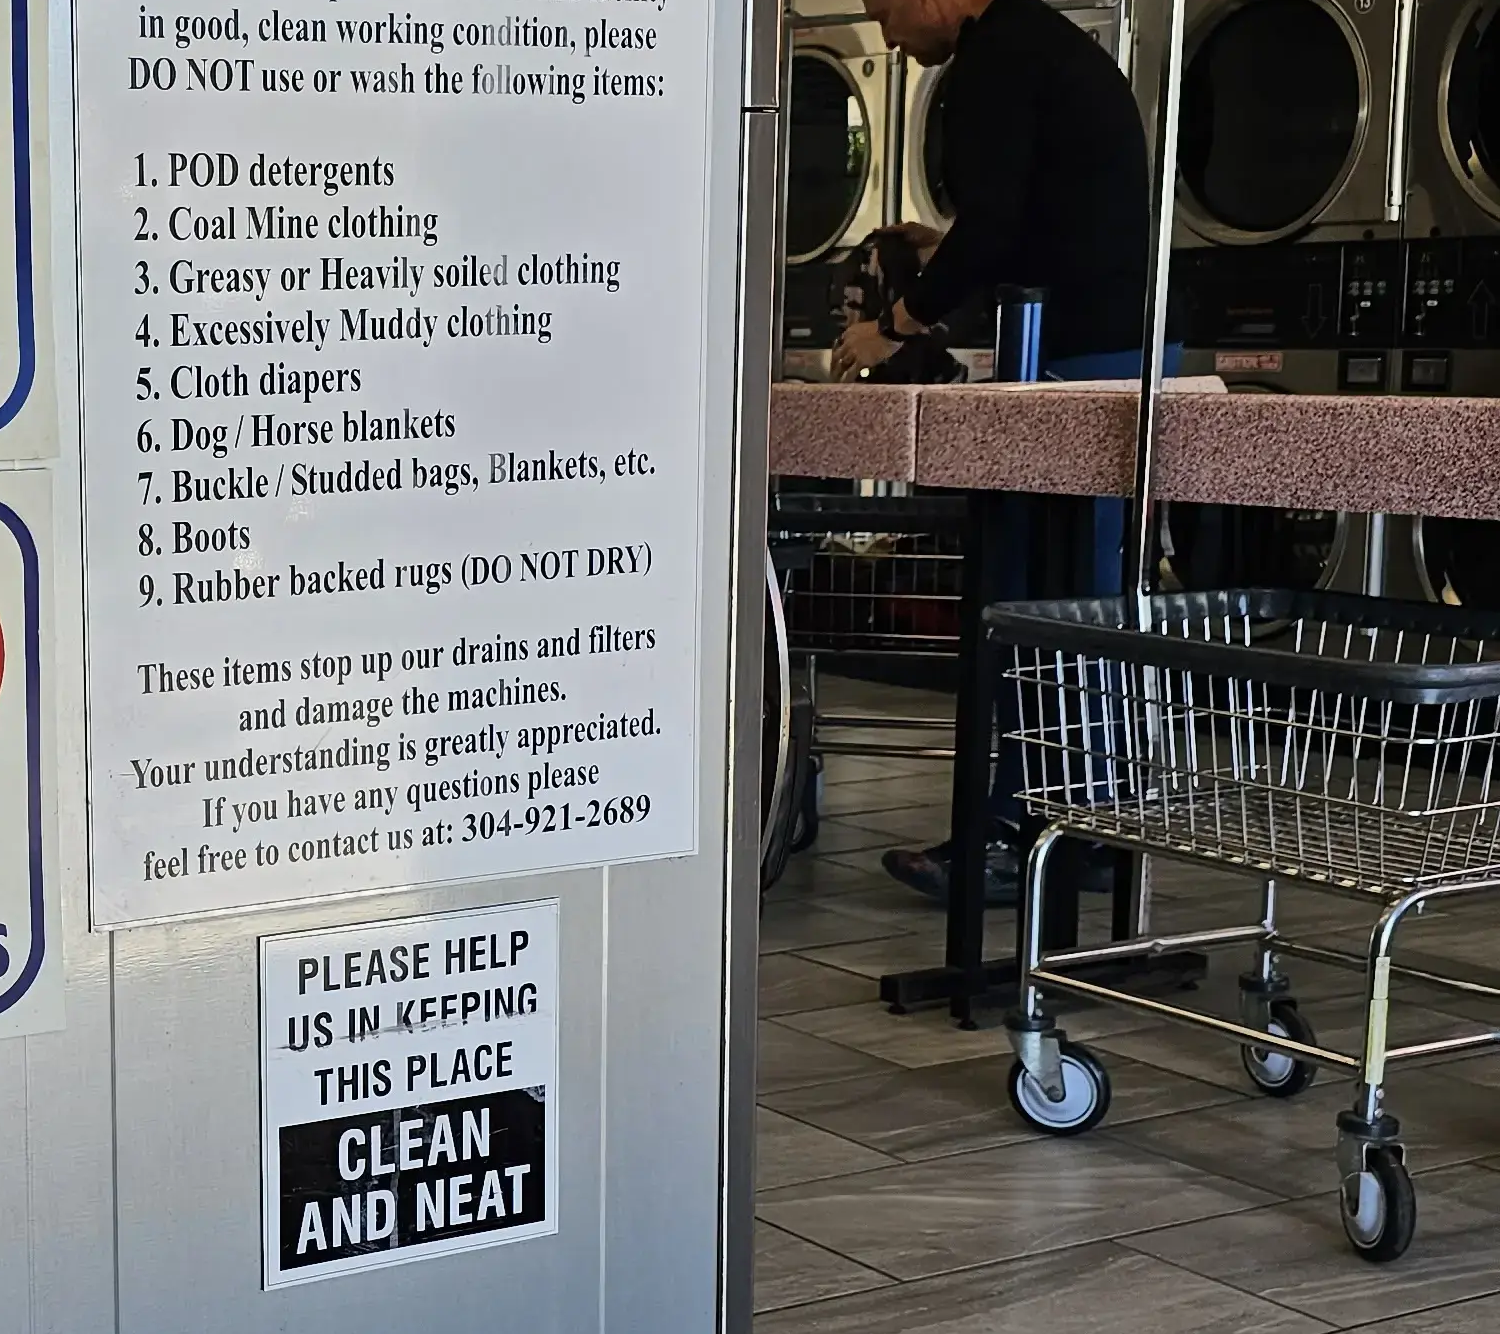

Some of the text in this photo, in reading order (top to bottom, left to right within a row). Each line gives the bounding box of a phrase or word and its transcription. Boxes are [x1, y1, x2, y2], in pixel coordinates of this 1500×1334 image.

[139, 5, 657, 57] in good, clean working condition, please
[128, 57, 663, 104] DO NOT use or wash the following items:
[134, 153, 394, 196] 1. POD detergents
[134, 205, 438, 246] 2. Coal Mine clothing
[135, 253, 620, 301] 3. Greasy or Heavily soiled clothing
[135, 304, 552, 351] 4. Excessively Muddy clothing
[137, 362, 361, 403] 5. Cloth diapers
[137, 419, 160, 453] 6.
[170, 419, 228, 458] Dog
[251, 414, 333, 447] Horse
[343, 408, 455, 442] blankets
[138, 472, 161, 505] 7.
[171, 467, 268, 502] Buckle
[292, 459, 402, 496] Studded
[412, 458, 478, 495] bags,
[488, 450, 605, 484] Blankets,
[615, 448, 655, 476] etc.
[139, 521, 250, 556] 8. Boots
[139, 541, 651, 608] 9. Rubber backed rugs (DO NOT DRY)
[137, 625, 655, 694] These items stop up our drains and filters
[240, 677, 566, 731] and damage the machines.
[130, 708, 660, 789] Your understanding is greatly appreciated.
[202, 762, 599, 833] If you have any questions please
[144, 795, 650, 881] feel free to contact us at: 304-921-2689
[298, 930, 529, 995] PLEASE HELP
[287, 982, 538, 1052] US IN KEEPING
[315, 1041, 513, 1106] THIS PLACE
[338, 1107, 490, 1181] CLEAN
[297, 1163, 530, 1255] AND NEAT
